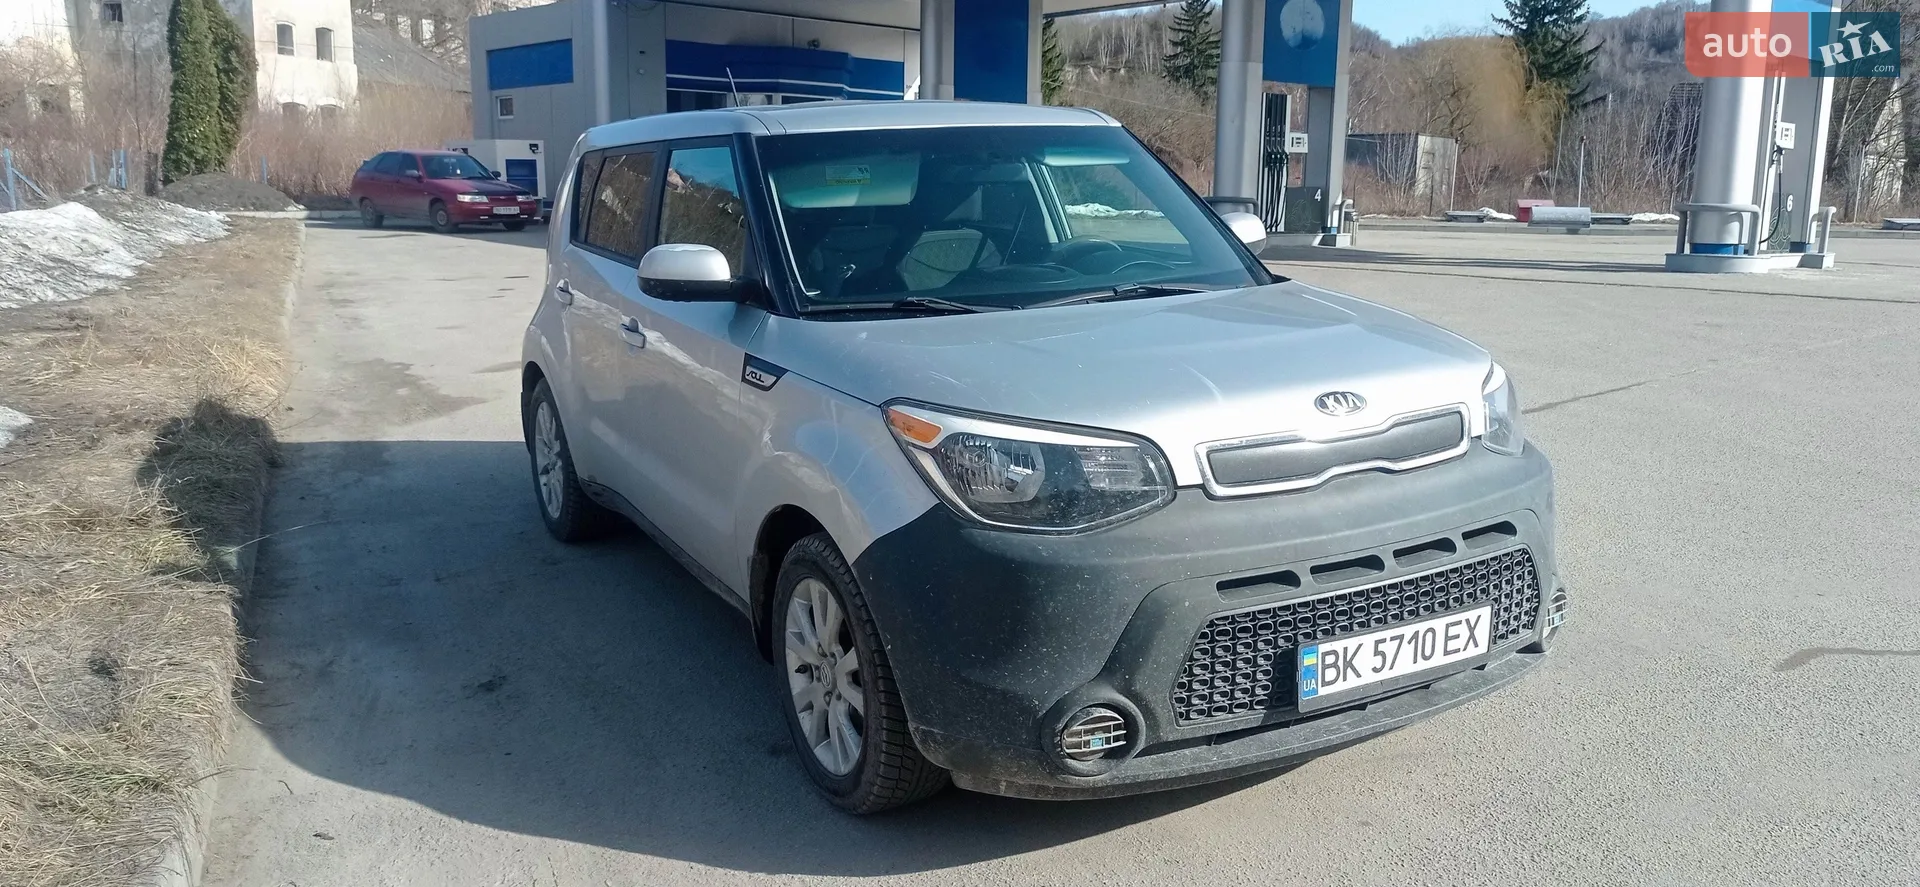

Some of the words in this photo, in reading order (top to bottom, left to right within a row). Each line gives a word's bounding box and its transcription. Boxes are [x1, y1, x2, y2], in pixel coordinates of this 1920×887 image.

[1314, 188, 1322, 202] 4
[1786, 194, 1794, 212] 6
[1321, 392, 1362, 413] KIA
[1321, 643, 1364, 688] BK
[1371, 627, 1437, 673] 5710
[1443, 614, 1482, 657] EX
[1303, 678, 1317, 692] UA
